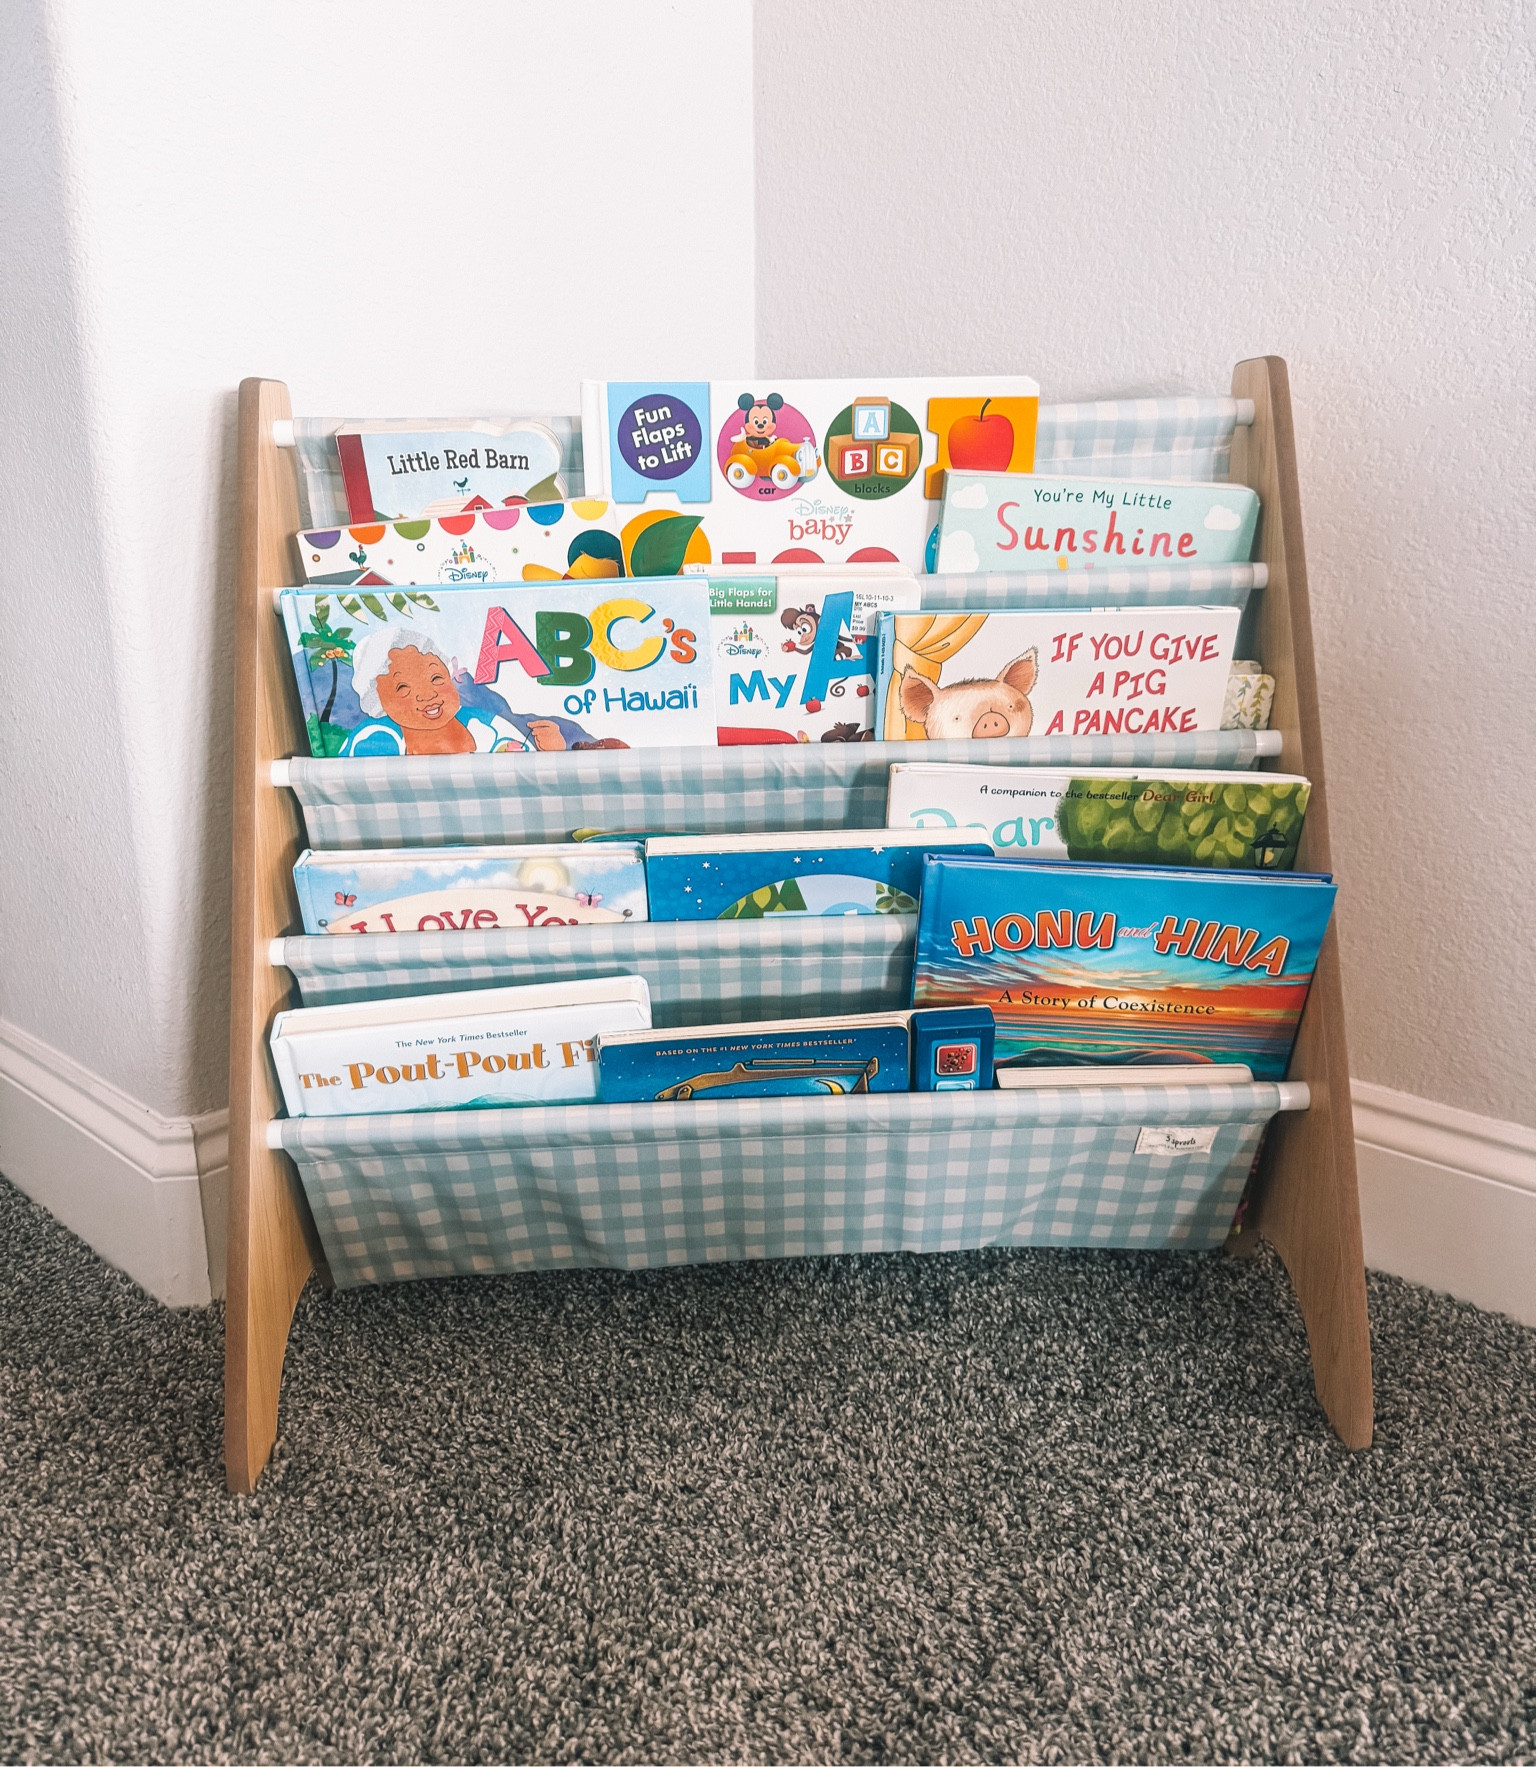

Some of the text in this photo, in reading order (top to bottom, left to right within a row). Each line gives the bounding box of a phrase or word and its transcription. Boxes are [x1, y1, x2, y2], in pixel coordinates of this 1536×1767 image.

[634, 406, 671, 426] Fun
[863, 412, 880, 432] A
[632, 424, 685, 448] Flaps
[387, 448, 530, 475] Little Red Barn
[638, 442, 692, 470] to Lift
[850, 451, 898, 470] B C
[758, 486, 777, 495] car
[854, 483, 890, 494] blocks
[1034, 489, 1172, 510] You're My Little
[792, 498, 849, 521] Disney
[788, 518, 853, 545] baby
[996, 501, 1197, 558] Sunshine
[445, 568, 488, 582] Disney
[709, 587, 773, 598] Big Flaps for
[710, 599, 772, 608] Little Hands!
[474, 598, 697, 686] ABC's
[724, 644, 762, 659] Disney
[1051, 630, 1220, 665] IF YOU GIVE
[730, 669, 797, 709] My
[1085, 668, 1167, 700] A PIG
[563, 689, 597, 715] of
[1044, 707, 1198, 735] A PANCAKE
[980, 784, 988, 795] A
[991, 788, 1047, 798] companion
[1050, 789, 1062, 798] to
[1065, 788, 1083, 799] the
[1086, 789, 1139, 801] bestseller
[1142, 789, 1180, 802] Dear
[909, 808, 1055, 848] Dar
[951, 908, 1291, 977] HONU and HINA
[999, 990, 1216, 1016] A Story of Coexistence
[437, 1036, 456, 1044] York
[486, 1030, 527, 1039] Bestseller
[802, 1039, 853, 1047] BESTSELLER
[299, 1072, 342, 1089] The
[342, 1043, 550, 1090] Pout-Pout
[1171, 1138, 1196, 1147] sprouts
